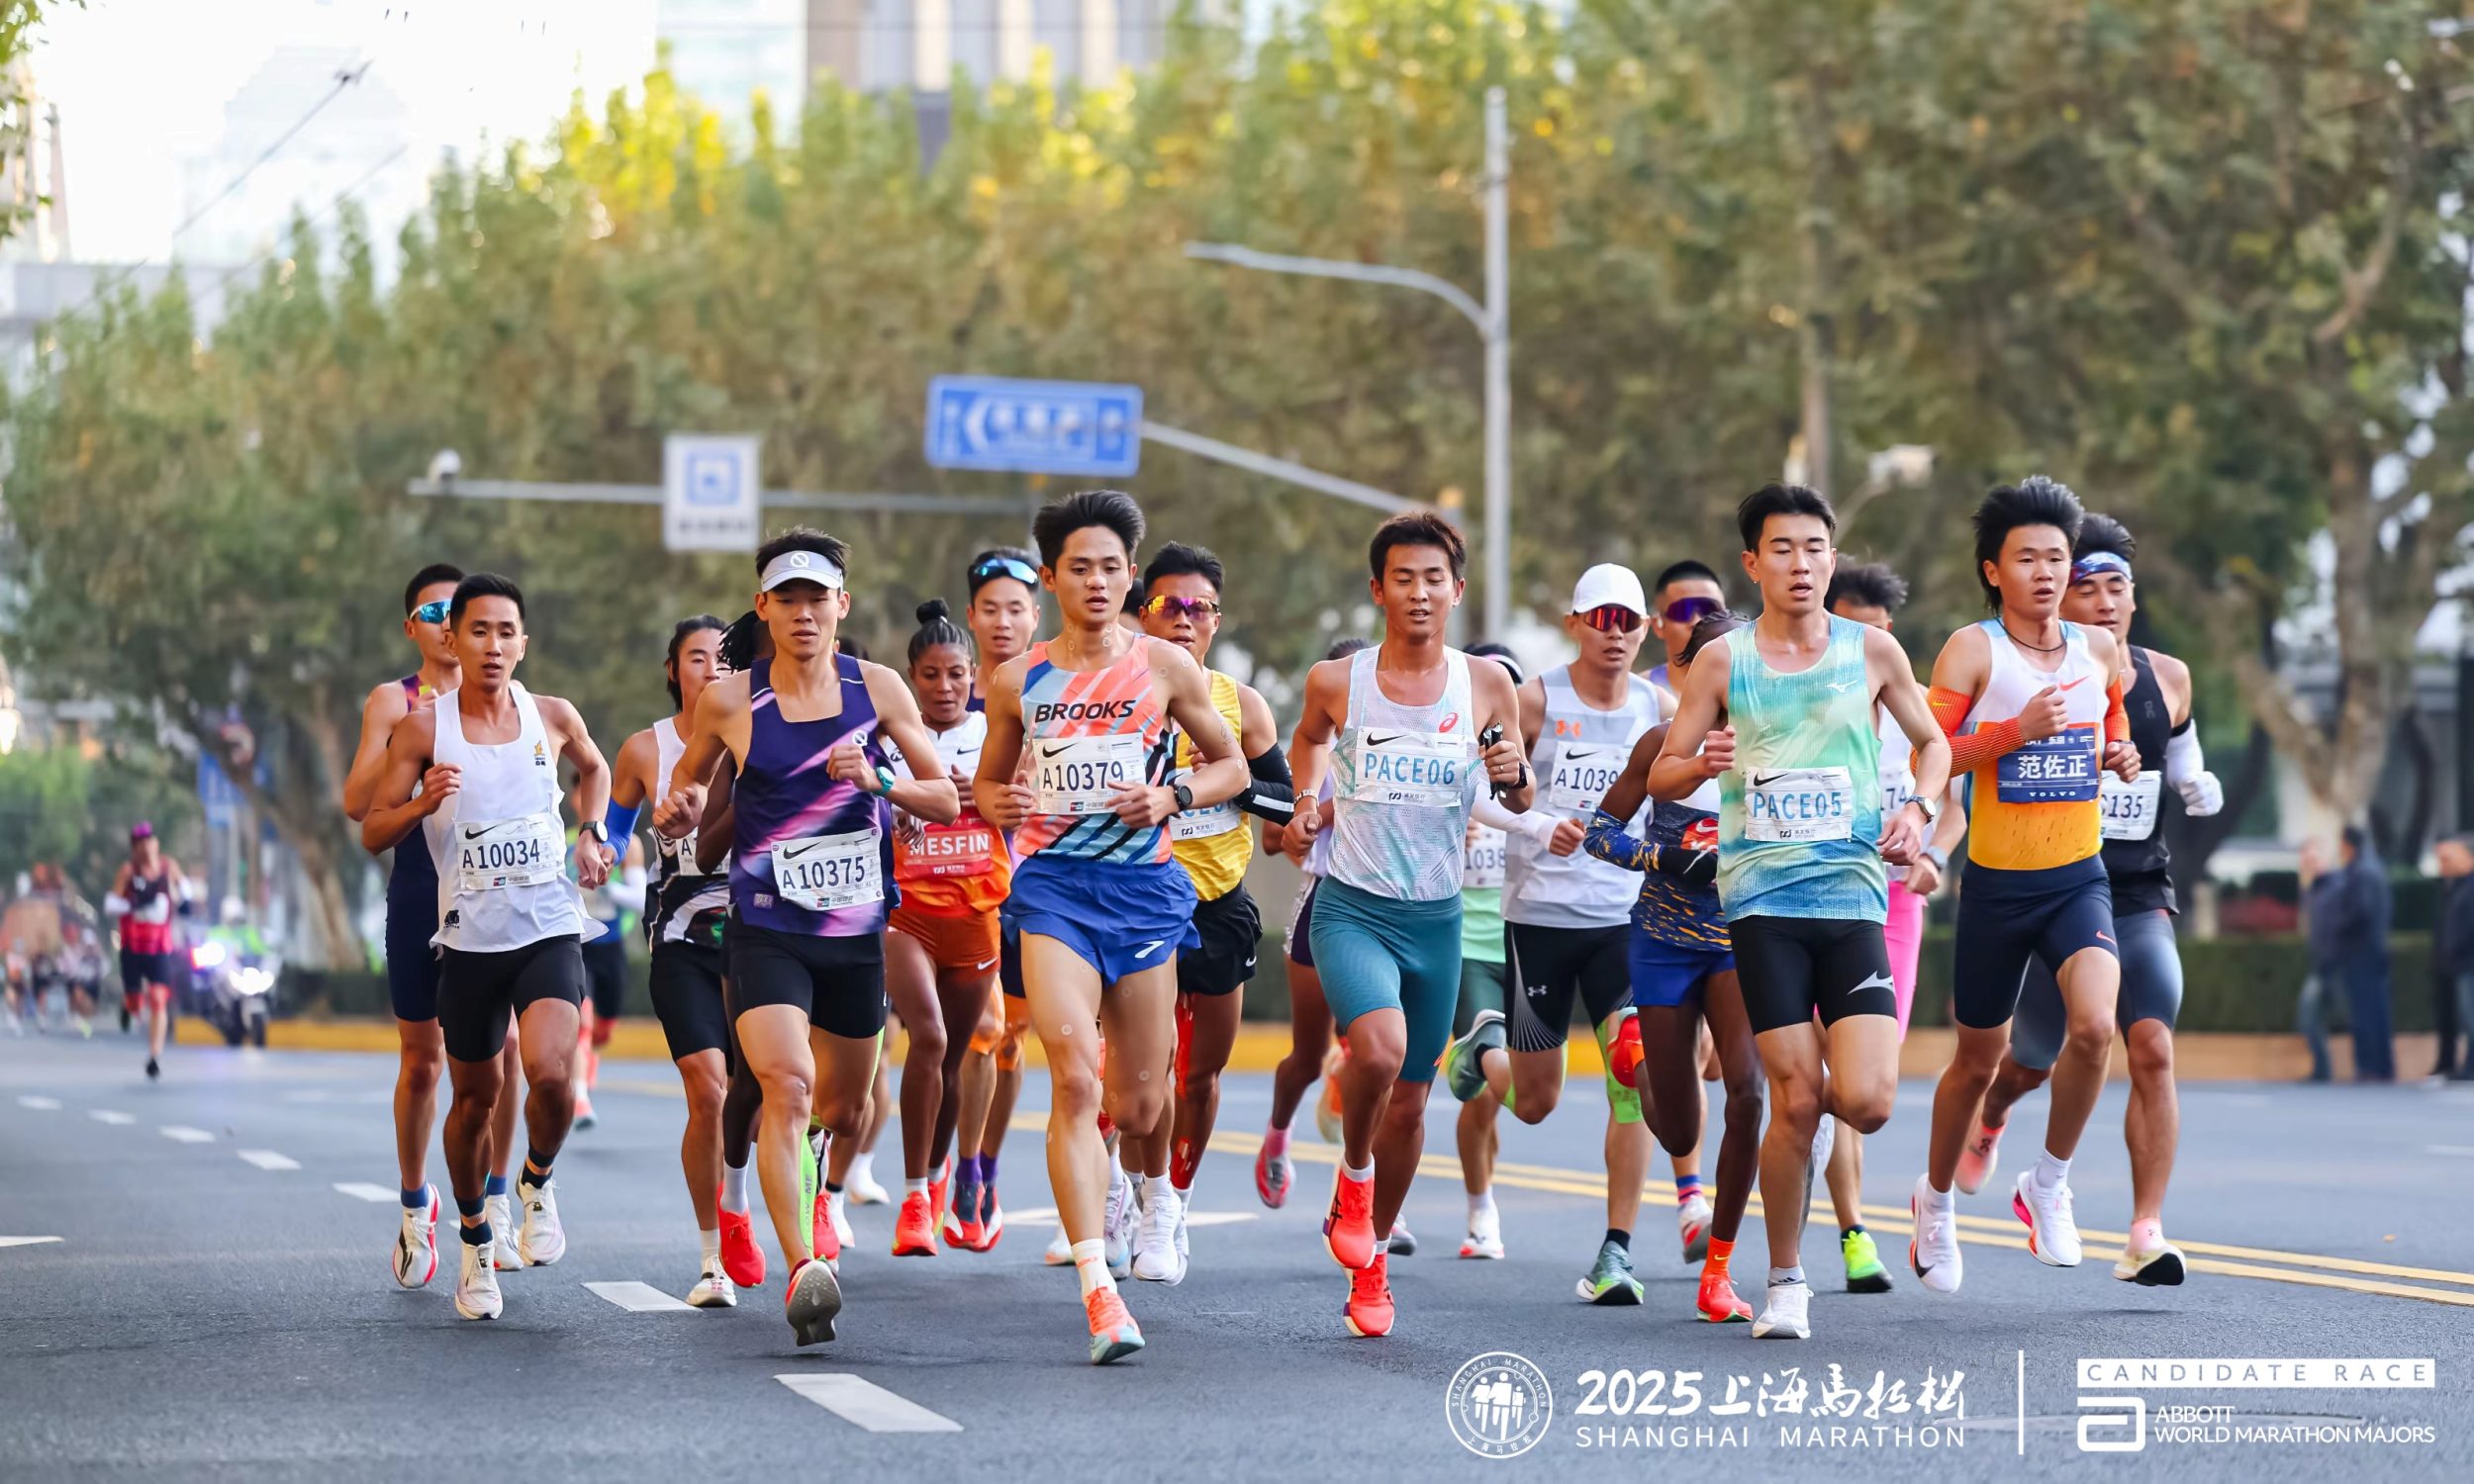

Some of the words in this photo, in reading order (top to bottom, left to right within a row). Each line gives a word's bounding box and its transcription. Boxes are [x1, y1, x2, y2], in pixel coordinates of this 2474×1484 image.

[1035, 699, 1136, 723] BROOKS
[1043, 761, 1124, 791] A10379
[1364, 752, 1455, 786] PACE06
[2018, 755, 2088, 779] 范佐正
[1753, 791, 1842, 819] PACE05
[462, 838, 540, 870] A10034
[908, 833, 989, 856] MESFIN
[783, 856, 865, 889] A10375
